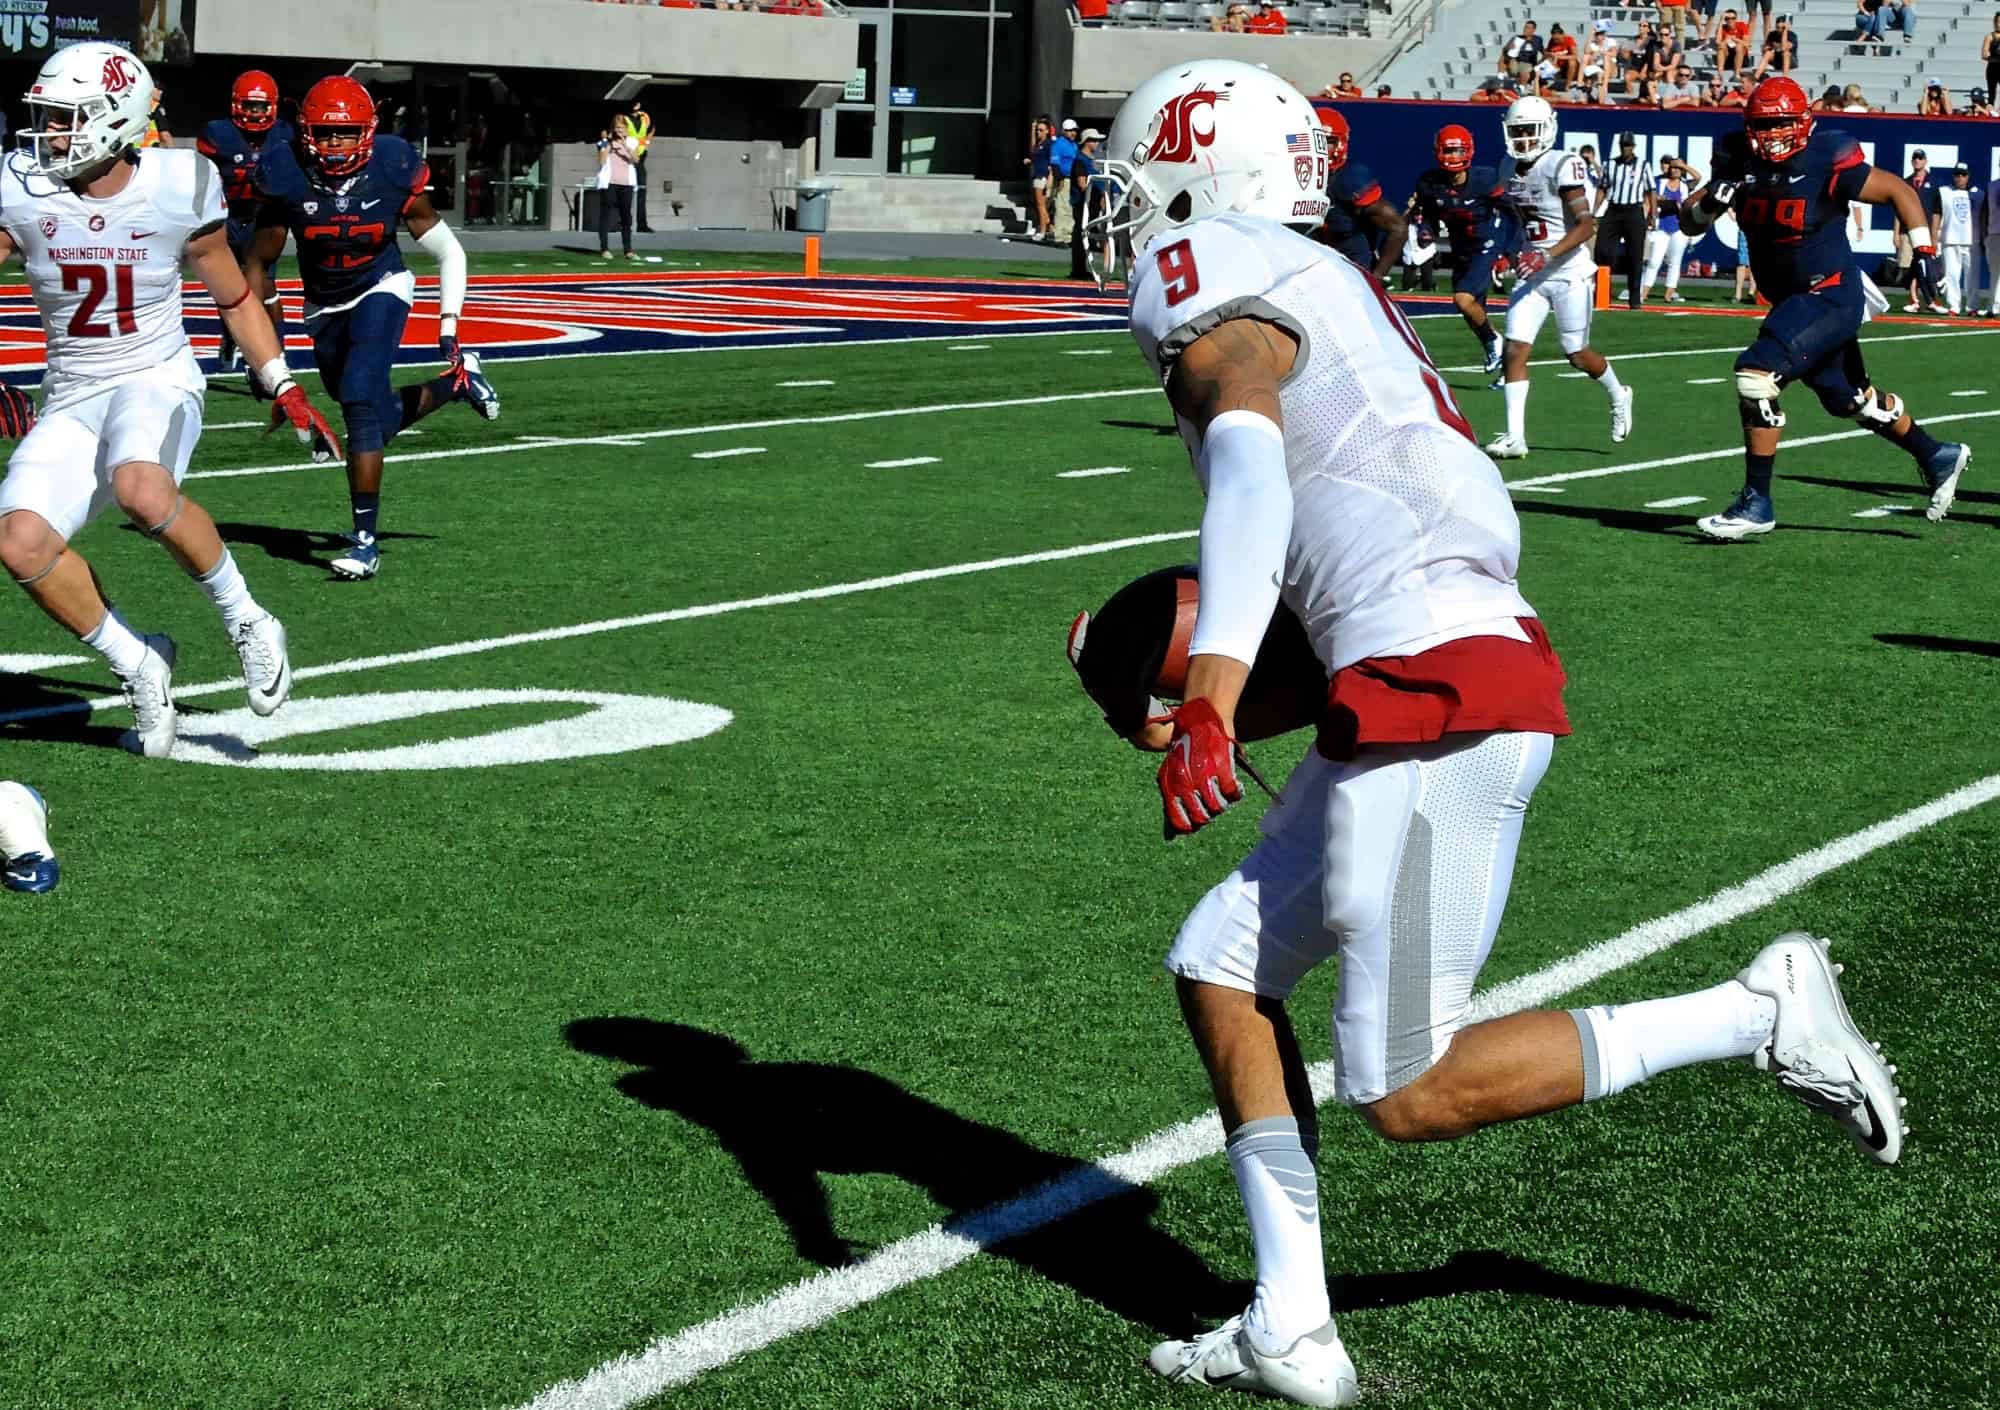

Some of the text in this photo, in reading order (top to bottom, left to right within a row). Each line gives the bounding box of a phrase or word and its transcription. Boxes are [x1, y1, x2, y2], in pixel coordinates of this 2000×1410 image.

[0, 13, 49, 52] y's
[1571, 161, 1585, 181] 15
[48, 247, 149, 261] WASHINGTON STATE
[1154, 238, 1201, 308] 9
[56, 263, 139, 338] 21
